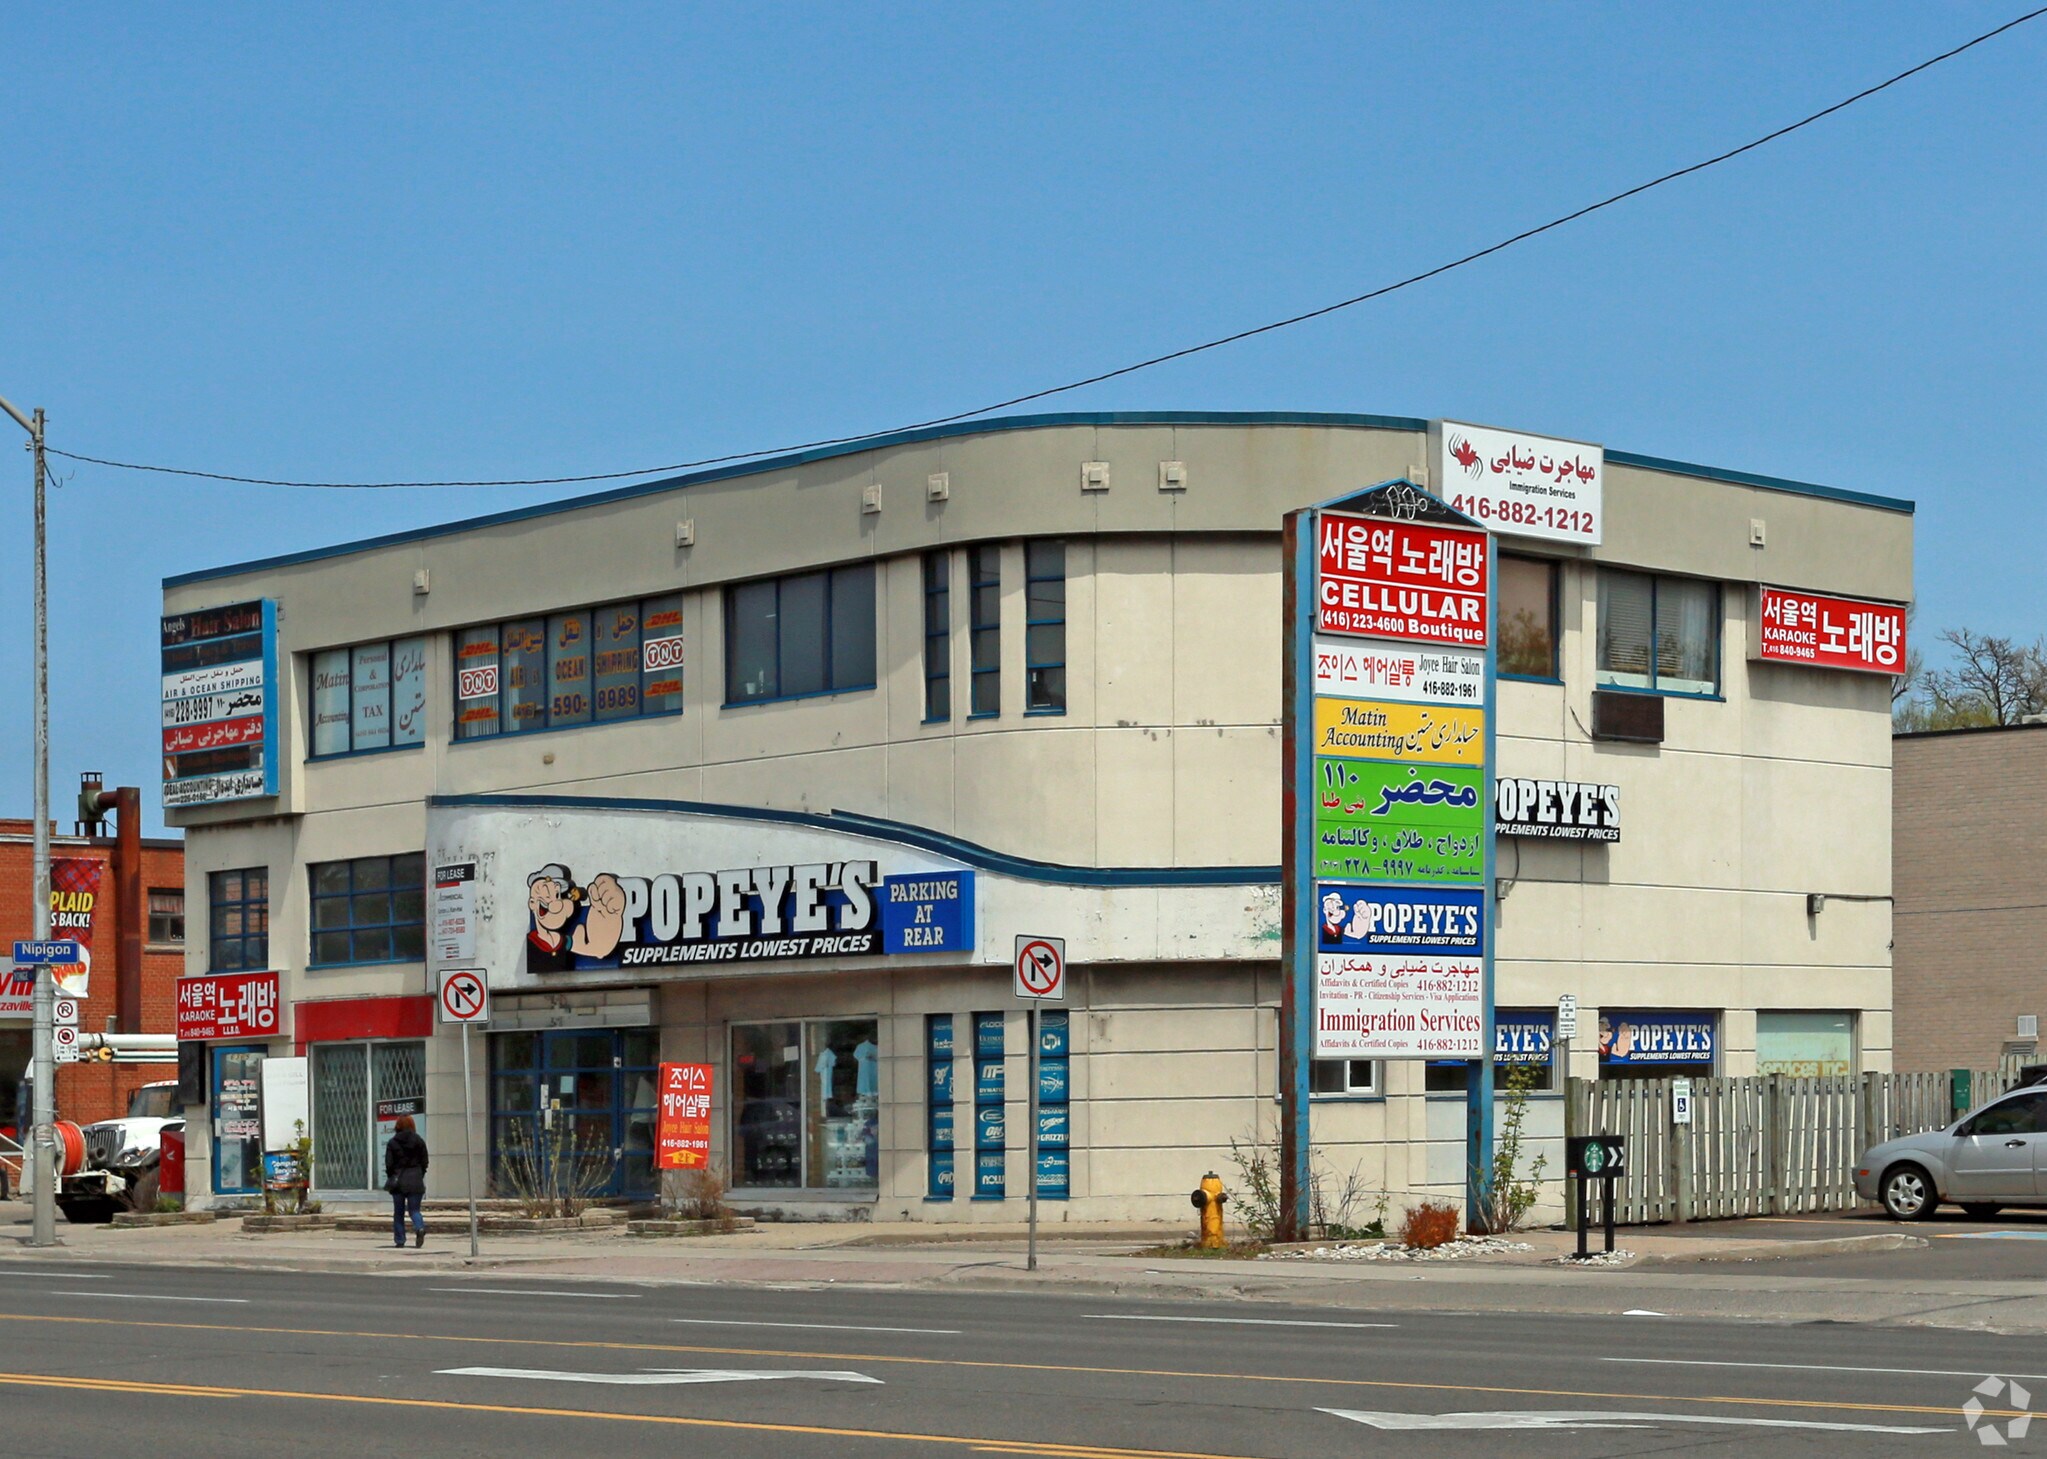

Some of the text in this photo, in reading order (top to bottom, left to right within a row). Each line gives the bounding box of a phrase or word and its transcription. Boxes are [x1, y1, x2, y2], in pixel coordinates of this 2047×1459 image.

[1539, 455, 1595, 484] مهاجرت
[1509, 480, 1576, 499] Immigration Services
[1451, 494, 1594, 533] 416-882-1212
[1321, 522, 1483, 586] 서울역 노래방
[1321, 581, 1480, 622] CELLULAR
[1320, 610, 1484, 642] (416) 223-4600 Boutique
[1764, 597, 1901, 665] 서울역 노래방
[1764, 627, 1817, 645] KARAOKE
[647, 642, 683, 666] TNT
[1779, 644, 1815, 658] 840-9465
[369, 669, 377, 680] &
[556, 656, 585, 683] OCEAN
[595, 648, 639, 676] SHIPPING
[1317, 654, 1415, 687] 조이스 헤어살롱
[1418, 654, 1480, 676] Joyce Hair Salon
[164, 689, 178, 698] AIR
[190, 682, 217, 695] OCEAN
[220, 675, 261, 690] SHIPPING
[316, 670, 350, 691] Matin
[462, 671, 495, 693] TNT
[597, 683, 638, 711] 8989
[362, 705, 383, 718] TAX
[1341, 706, 1387, 727] Matin
[241, 719, 262, 741] دفتر
[1321, 727, 1404, 755] Accounting
[1370, 767, 1478, 816] محضر
[1496, 823, 1619, 840] PPLEMENTS LOWEST PRICES
[1436, 832, 1480, 857] ازدواج
[447, 868, 465, 880] LEASE
[50, 891, 94, 912] PLAID
[617, 860, 872, 942] POPEYE'S
[890, 881, 958, 902] PARKING
[59, 912, 90, 928] BACK!
[914, 904, 934, 924] AT
[1368, 903, 1478, 936] POPEYE'S
[904, 926, 944, 947] REAR
[1369, 934, 1477, 946] SUPPLEMENTS LOWEST PRICES
[21, 943, 71, 958] Nipigon
[622, 934, 872, 964] SUPPLEMENTS LOWEST PRICES
[1320, 958, 1372, 976] همکاران
[1378, 964, 1387, 976] و
[1431, 961, 1480, 978] مهاجرت
[1320, 979, 1351, 987] Affidavits
[1352, 979, 1358, 987] &
[1360, 979, 1387, 988] Certified
[1388, 979, 1409, 990] Copies
[179, 979, 277, 1028] 서울역 노래방
[1319, 991, 1479, 1003] Invitation PR Citizenship Services Visa Applications
[180, 1010, 216, 1022] KARAOKE
[1319, 1008, 1481, 1038] Immigration Services
[1320, 1039, 1350, 1048] Affidavits
[1351, 1039, 1357, 1048] &
[1359, 1039, 1387, 1048] Certified
[1387, 1039, 1408, 1050] Copies
[1496, 1024, 1550, 1052] EYE'S
[1628, 1024, 1711, 1051] POPEYE'S
[1630, 1051, 1711, 1060] SUPPLEMENTS LOWEST PRICES
[669, 1066, 706, 1090] 조이스
[379, 1102, 415, 1114] FOR LEASE
[663, 1093, 710, 1118] 헤어살롱
[680, 1121, 692, 1134] Hair
[694, 1121, 709, 1134] Salon
[678, 1152, 692, 1163] 2F
